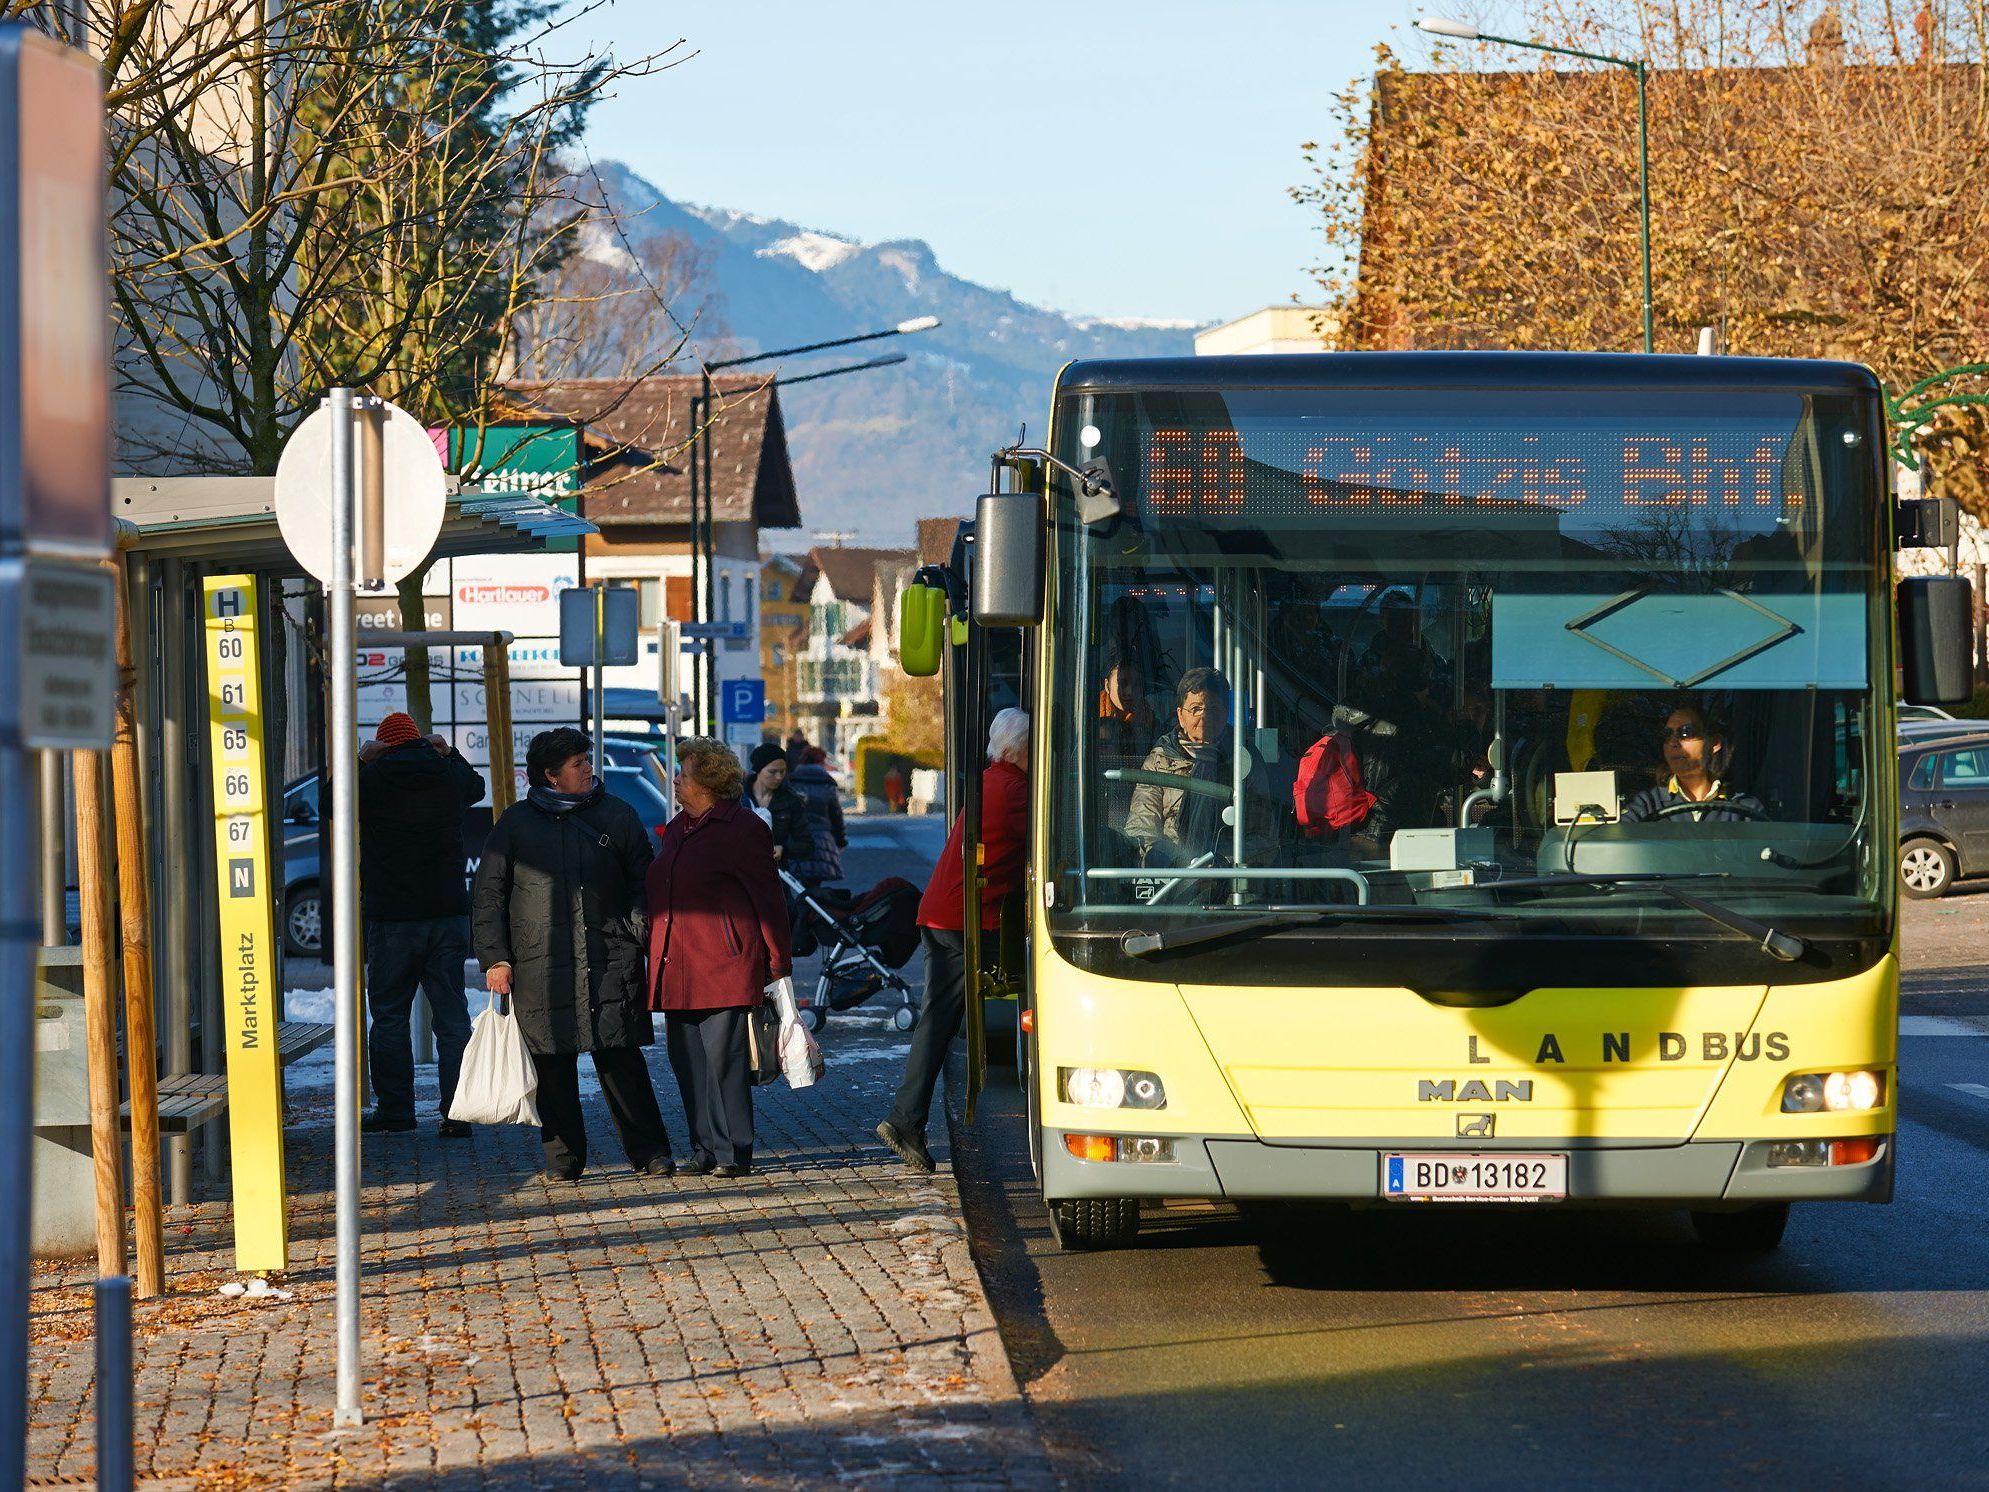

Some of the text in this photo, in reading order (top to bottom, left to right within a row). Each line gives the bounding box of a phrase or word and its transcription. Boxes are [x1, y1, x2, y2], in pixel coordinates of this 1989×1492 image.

[1150, 431, 1245, 514] 60
[217, 591, 240, 617] H
[464, 586, 545, 602] Hartlauer
[224, 619, 235, 632] B
[356, 608, 395, 628] reet
[219, 638, 242, 659] 60
[222, 683, 244, 705] 61
[460, 688, 577, 705] SCNELL
[734, 689, 753, 713] P
[223, 729, 247, 750] 65
[225, 774, 249, 796] 66
[229, 821, 251, 842] 67
[234, 867, 249, 888] N
[238, 932, 259, 1049] Marktplatz
[1418, 1079, 1533, 1102] MAN
[1471, 1162, 1547, 1189] 13182
